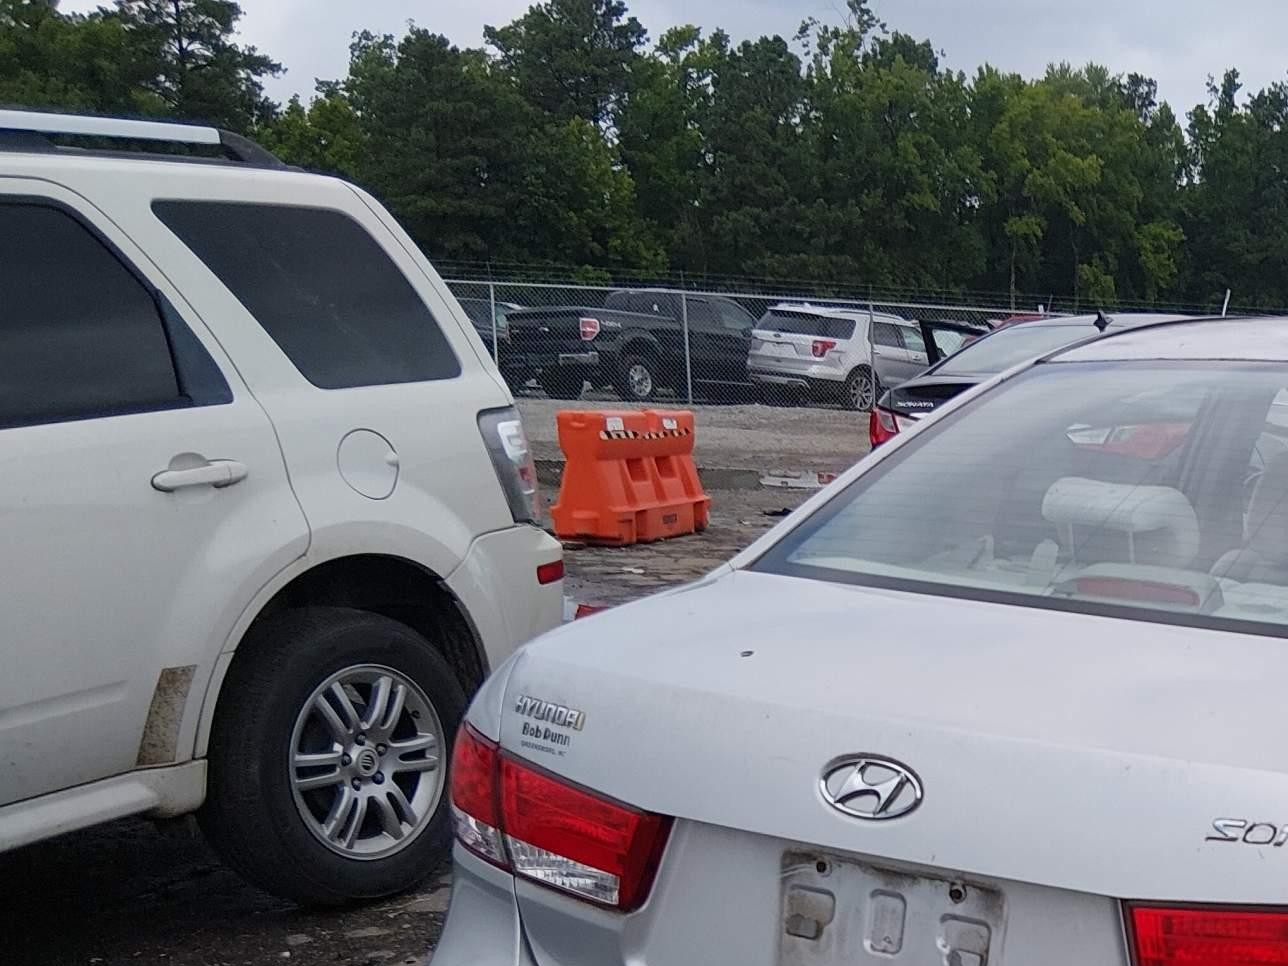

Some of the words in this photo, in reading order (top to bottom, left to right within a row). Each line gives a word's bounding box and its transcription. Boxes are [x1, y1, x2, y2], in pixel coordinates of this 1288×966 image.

[515, 695, 586, 732] HYUNDAI
[522, 721, 542, 739] Bob
[543, 727, 571, 747] Dunn
